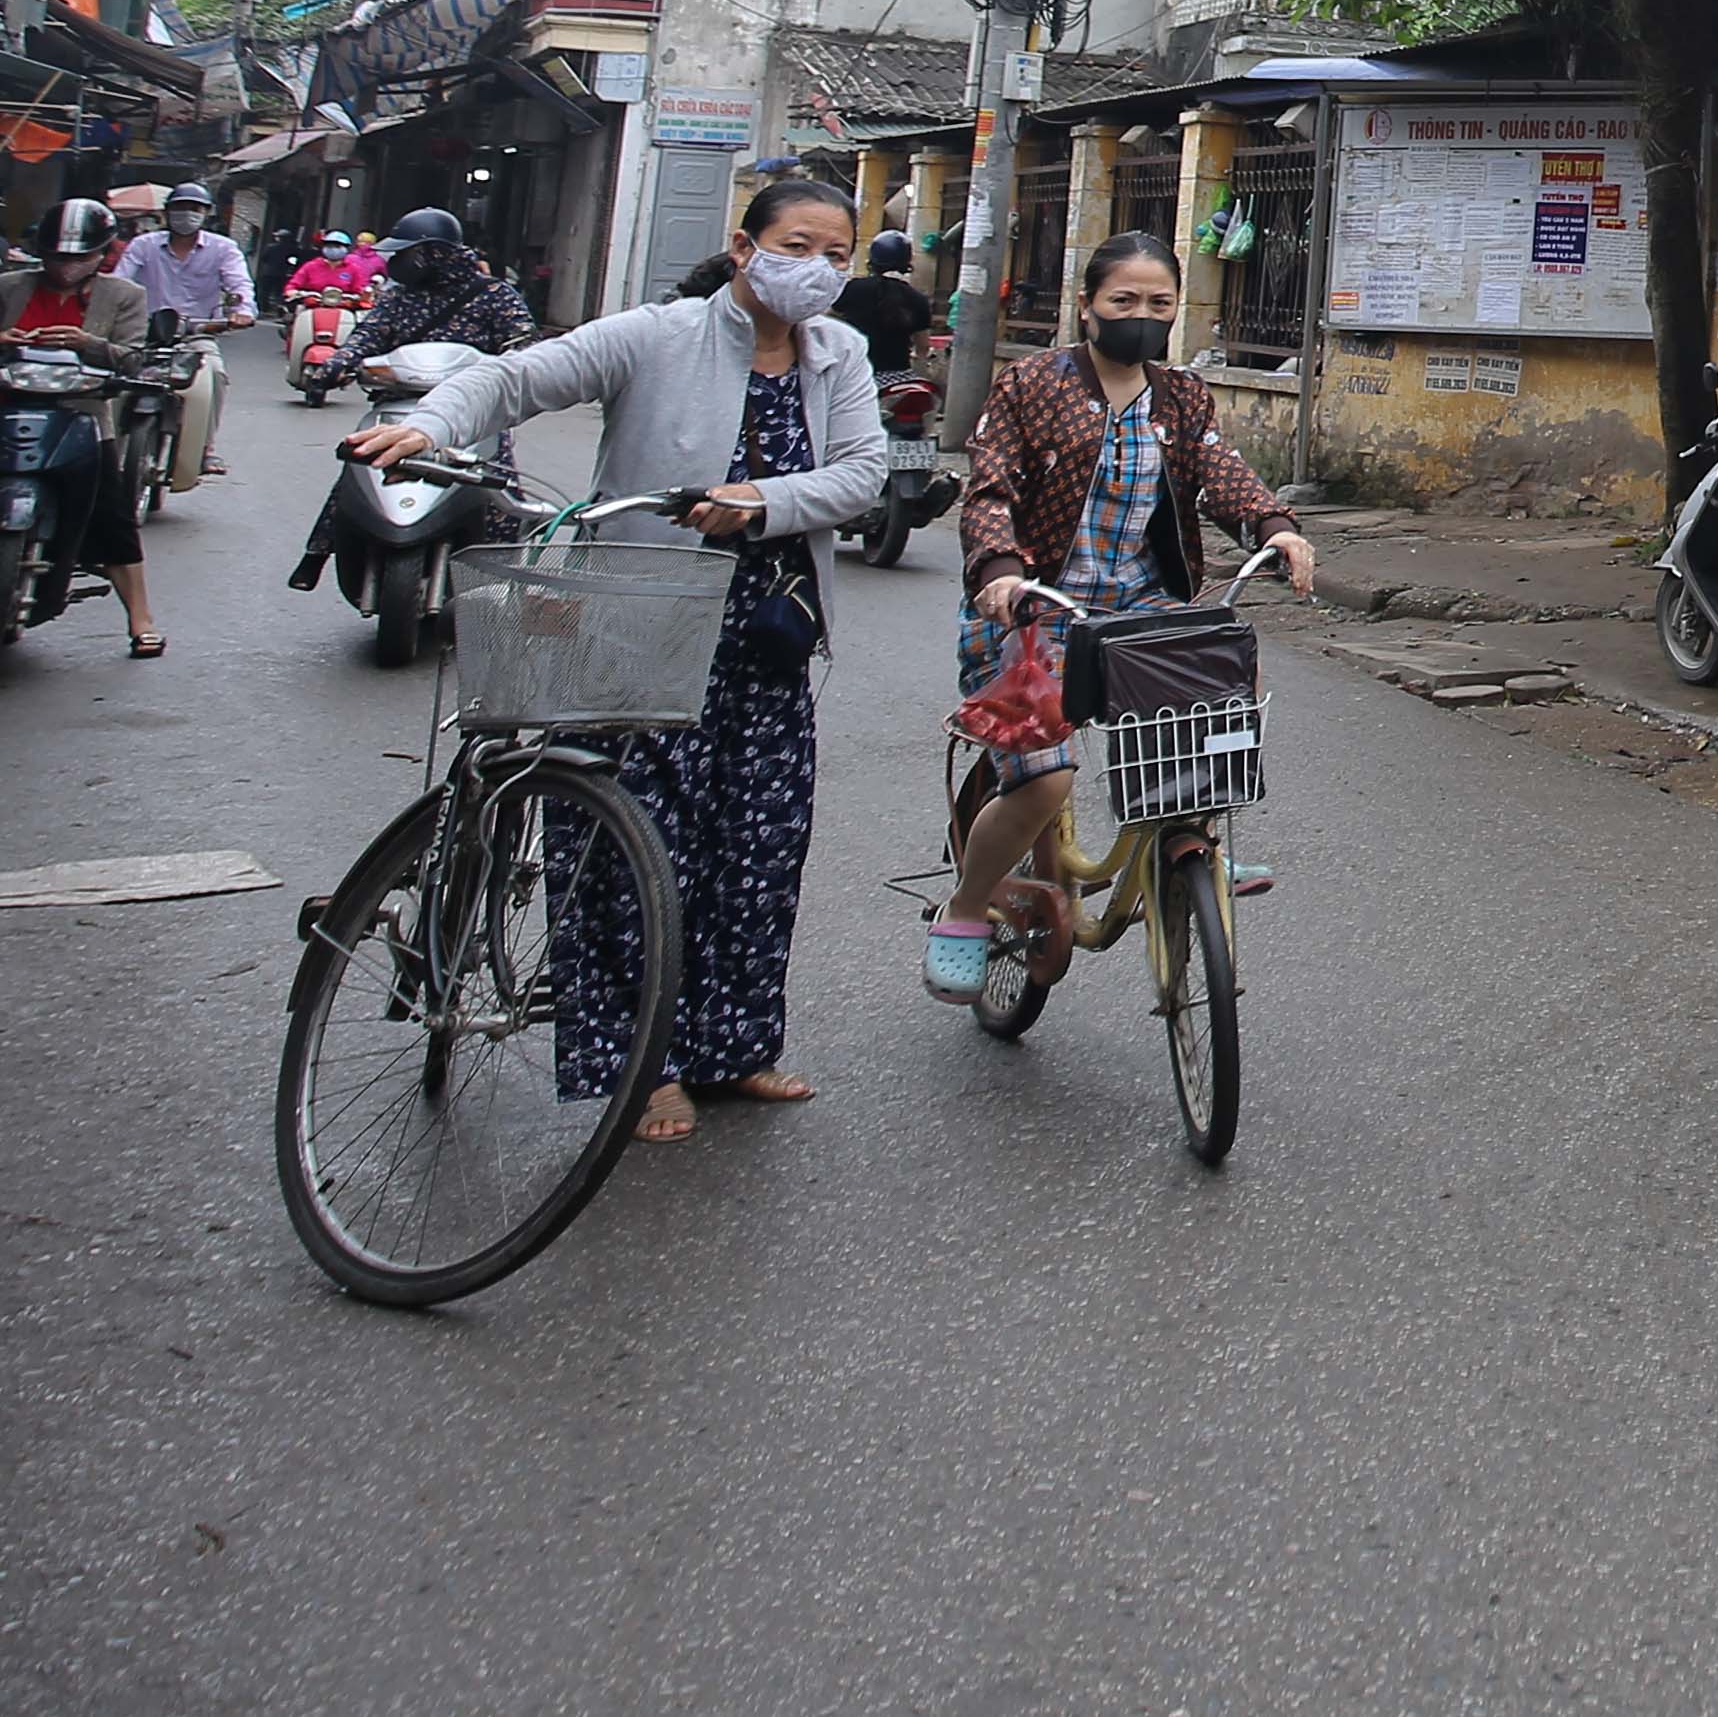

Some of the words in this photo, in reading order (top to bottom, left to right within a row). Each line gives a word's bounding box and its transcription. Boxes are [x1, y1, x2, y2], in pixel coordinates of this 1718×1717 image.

[1407, 116, 1455, 140] THÔNG
[1460, 120, 1484, 139] TIN
[1499, 113, 1550, 141] QUẢNG
[1555, 115, 1586, 140] CÁO
[1597, 120, 1628, 139] RAO
